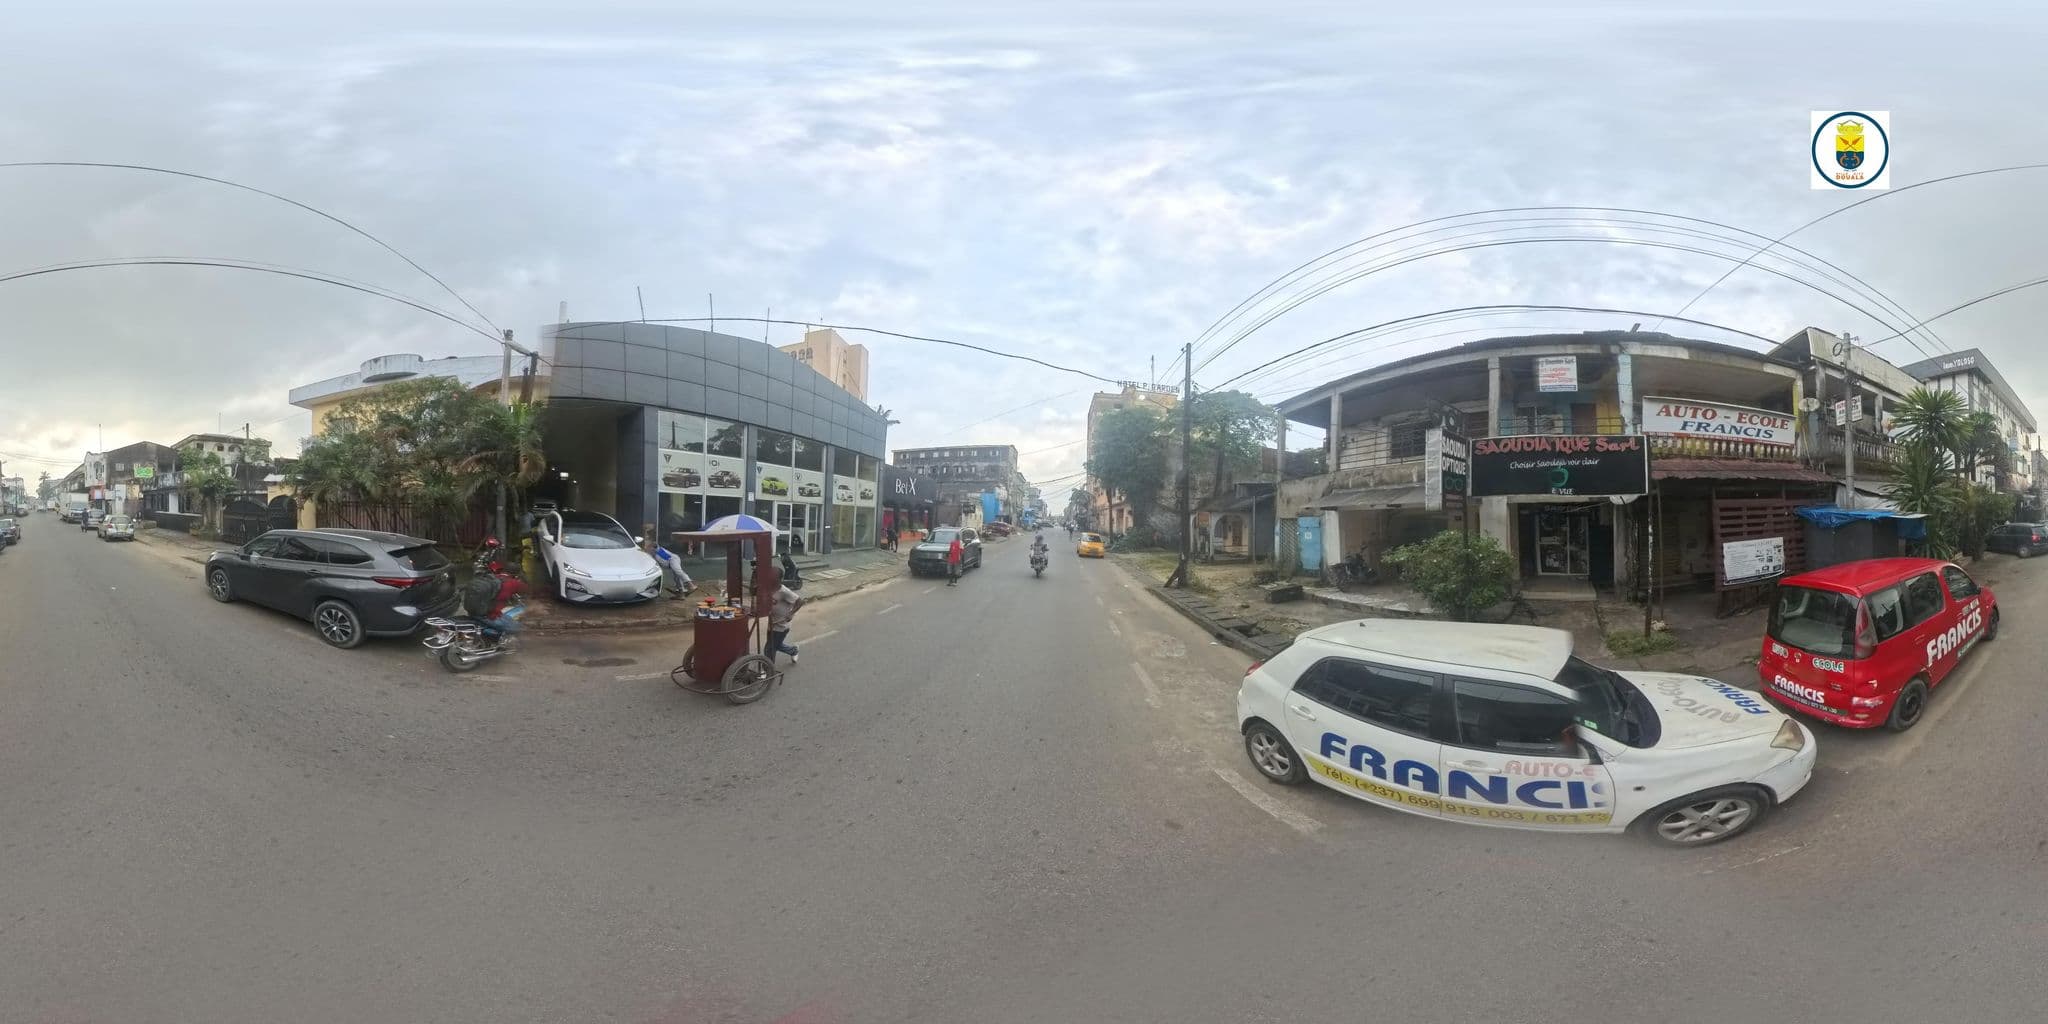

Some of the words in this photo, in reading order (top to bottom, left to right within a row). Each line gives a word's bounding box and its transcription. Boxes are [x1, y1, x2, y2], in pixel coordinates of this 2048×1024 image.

[1656, 404, 1718, 421] AUTO
[1736, 411, 1790, 430] ECOLE
[1680, 420, 1775, 439] FRANCIS
[1595, 437, 1640, 453] Sarl
[1441, 456, 1466, 475] OPTIQUE
[1509, 460, 1536, 469] Choisir
[1567, 458, 1581, 466] voir
[1926, 607, 1983, 668] FRANCIS
[1812, 657, 1844, 674] ECOLE
[1774, 674, 1825, 704] FRANCIS
[1322, 763, 1351, 786] Tél.:
[1354, 779, 1402, 802] (+237)
[1408, 792, 1440, 810] 699
[1449, 803, 1481, 817] 913
[1487, 807, 1526, 822] 003
[1545, 812, 1578, 824] 677
